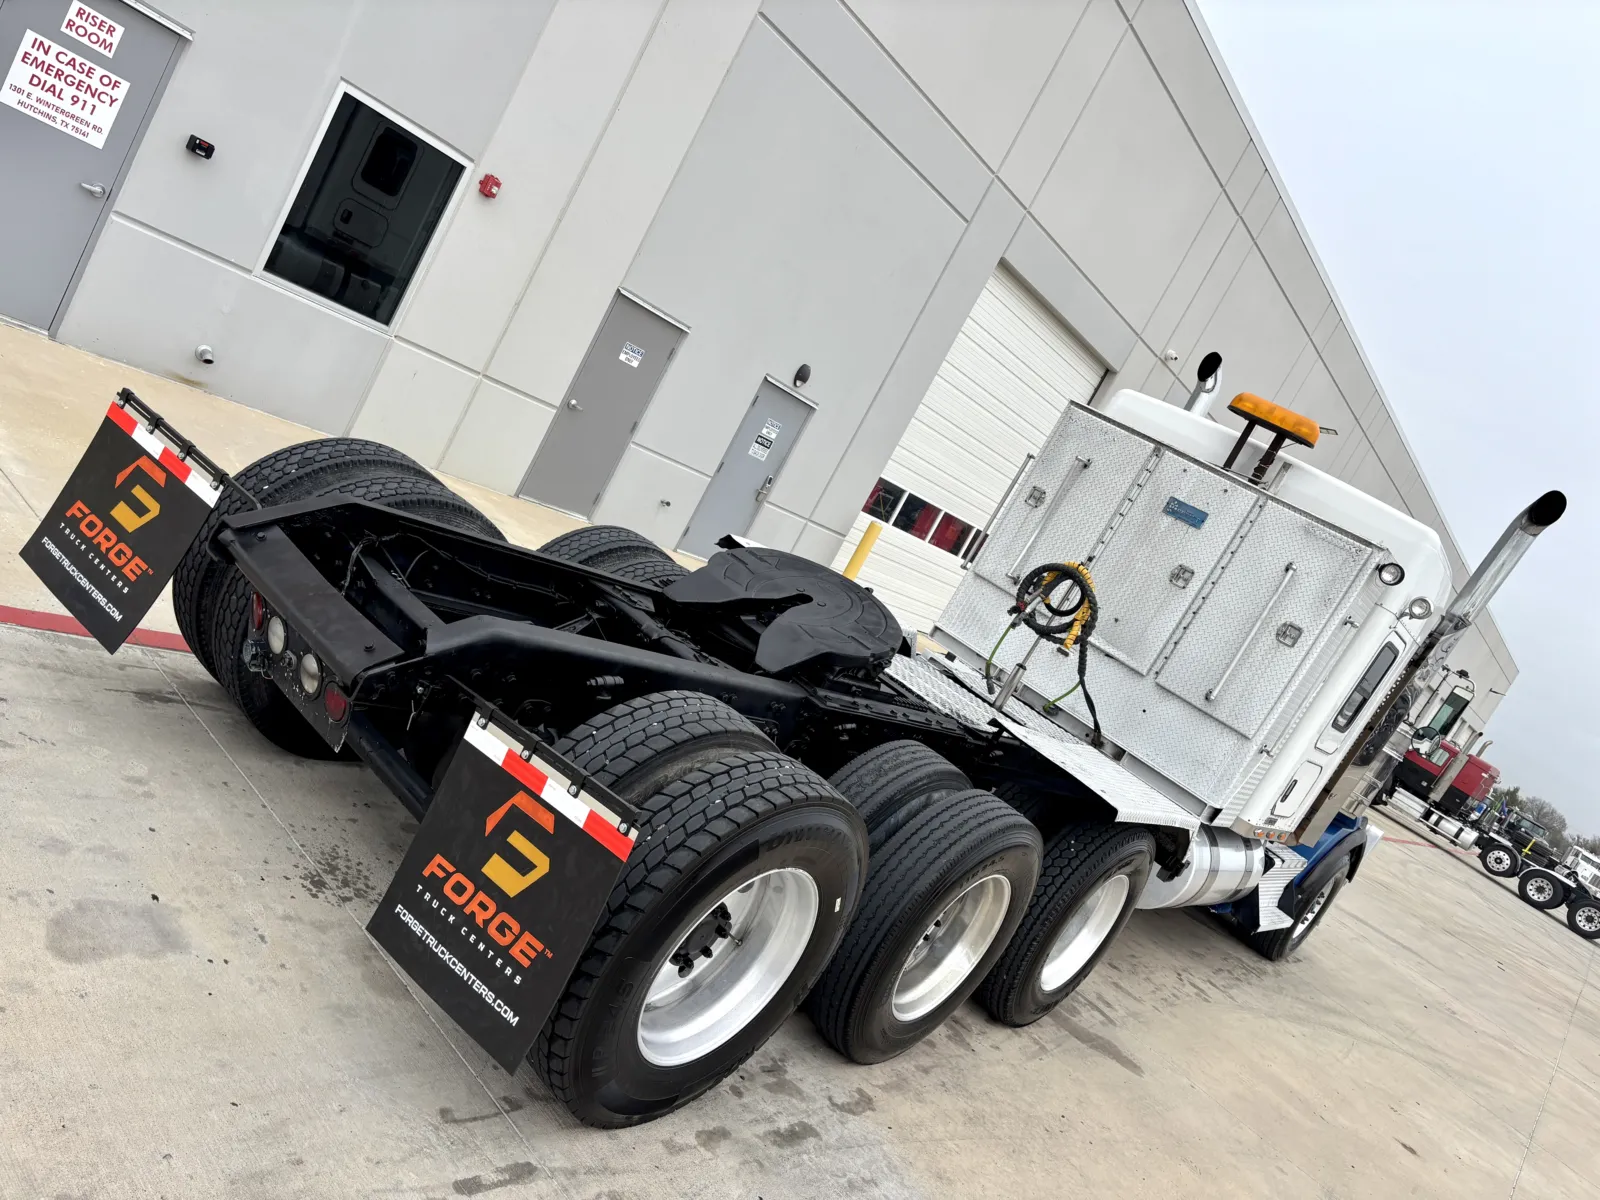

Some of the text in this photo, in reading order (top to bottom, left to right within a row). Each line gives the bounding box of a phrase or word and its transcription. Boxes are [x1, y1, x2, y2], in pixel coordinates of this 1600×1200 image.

[65, 18, 114, 54] ROOM
[75, 7, 117, 38] RISER
[20, 51, 119, 108] EMERGENCY
[31, 37, 122, 91] IN CASE OF
[9, 83, 104, 135] 1301 E. WINTERGREEN RD.
[16, 99, 89, 139] HUTCHINS, TX 75141
[28, 73, 97, 116] DIAL 911
[59, 522, 129, 594] TRUCK CENTERS
[64, 499, 149, 582] FORGE
[41, 536, 123, 623] FORGETRUCKCENTERS.COM
[416, 884, 523, 986] TRUCK CENTERS
[421, 853, 545, 968] FORGE
[394, 903, 521, 1027] FORGETRUCKCENTERS.COM
